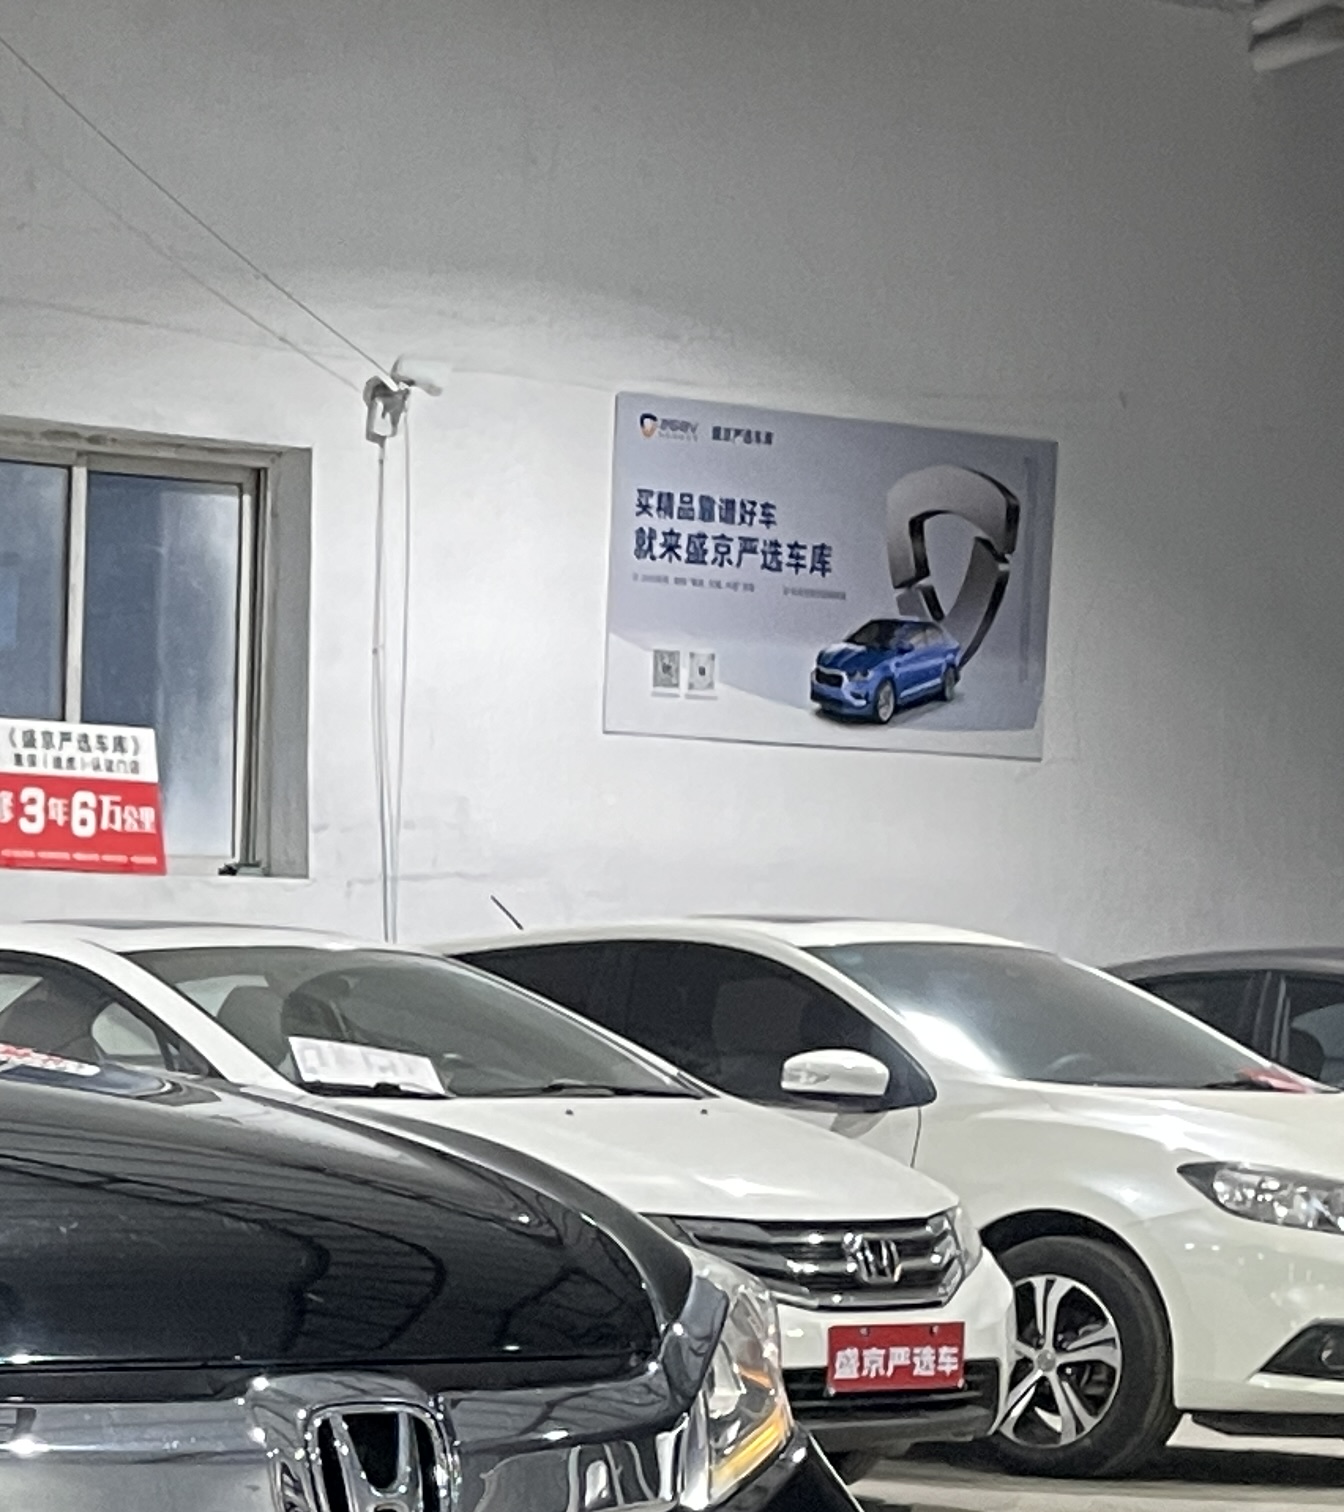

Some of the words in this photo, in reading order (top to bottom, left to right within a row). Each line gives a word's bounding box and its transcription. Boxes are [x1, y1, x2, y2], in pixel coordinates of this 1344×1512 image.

[634, 527, 832, 578] 就来盛京严选车库
[834, 1345, 959, 1379] 盛京严选车
